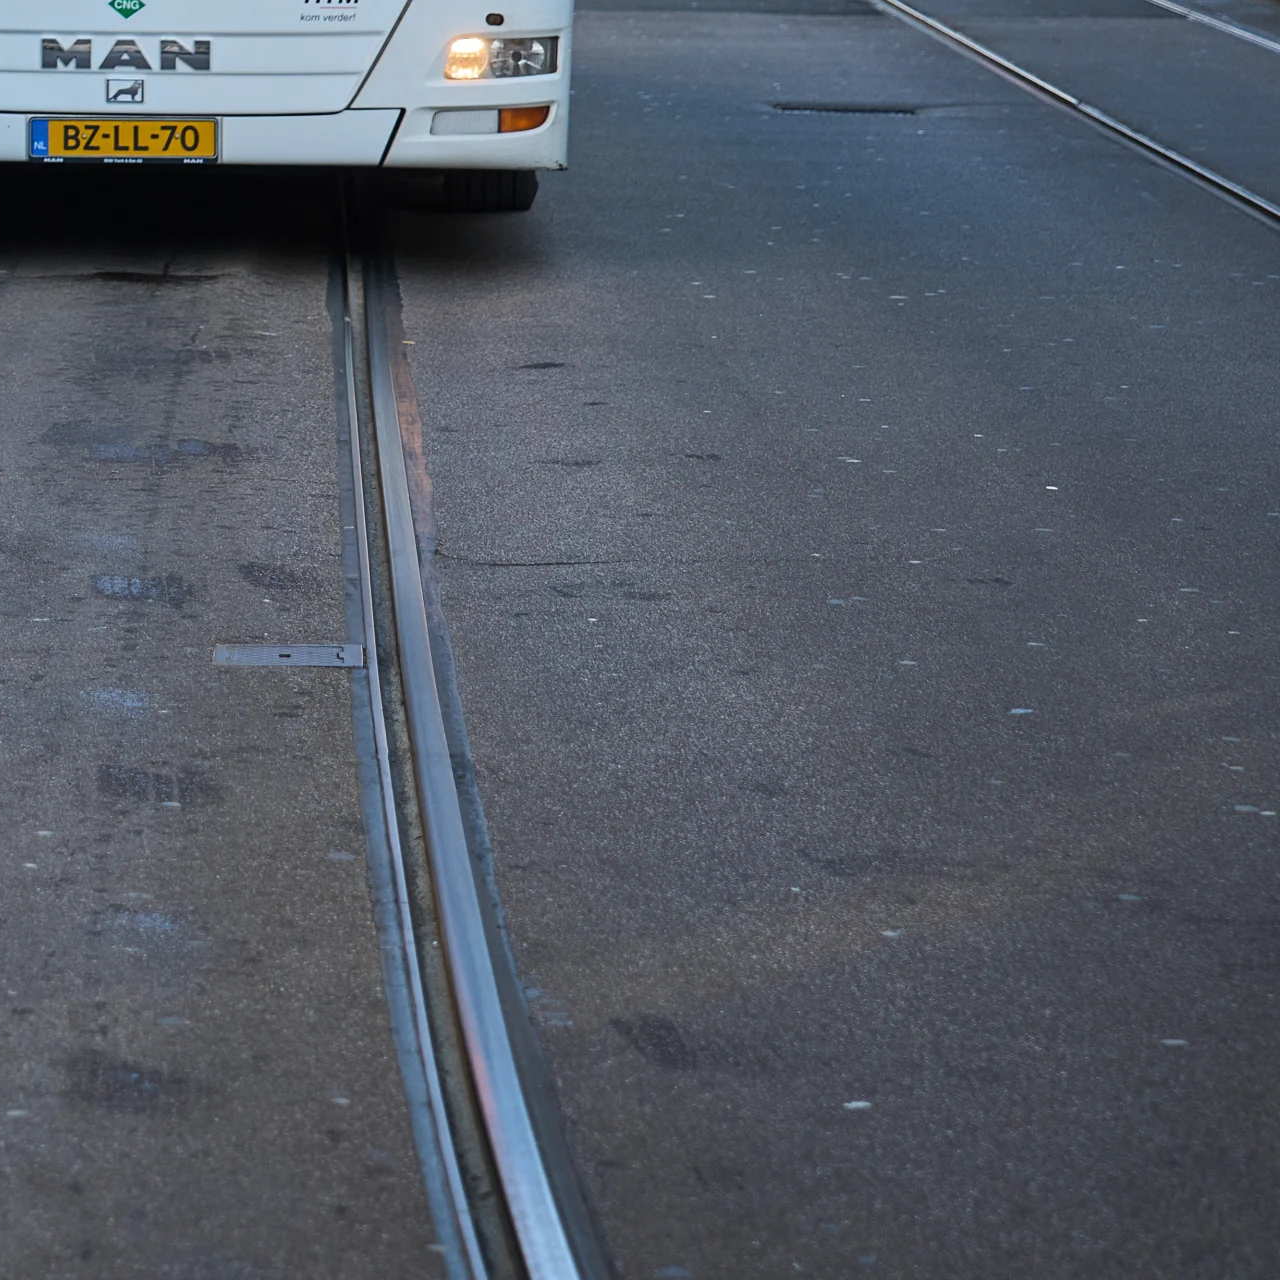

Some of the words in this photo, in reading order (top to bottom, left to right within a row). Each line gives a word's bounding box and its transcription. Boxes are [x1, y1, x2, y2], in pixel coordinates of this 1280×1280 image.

[300, 12, 321, 22] kom
[41, 37, 212, 71] MAN
[33, 141, 48, 151] NL
[62, 124, 201, 153] BZ-LL-70
